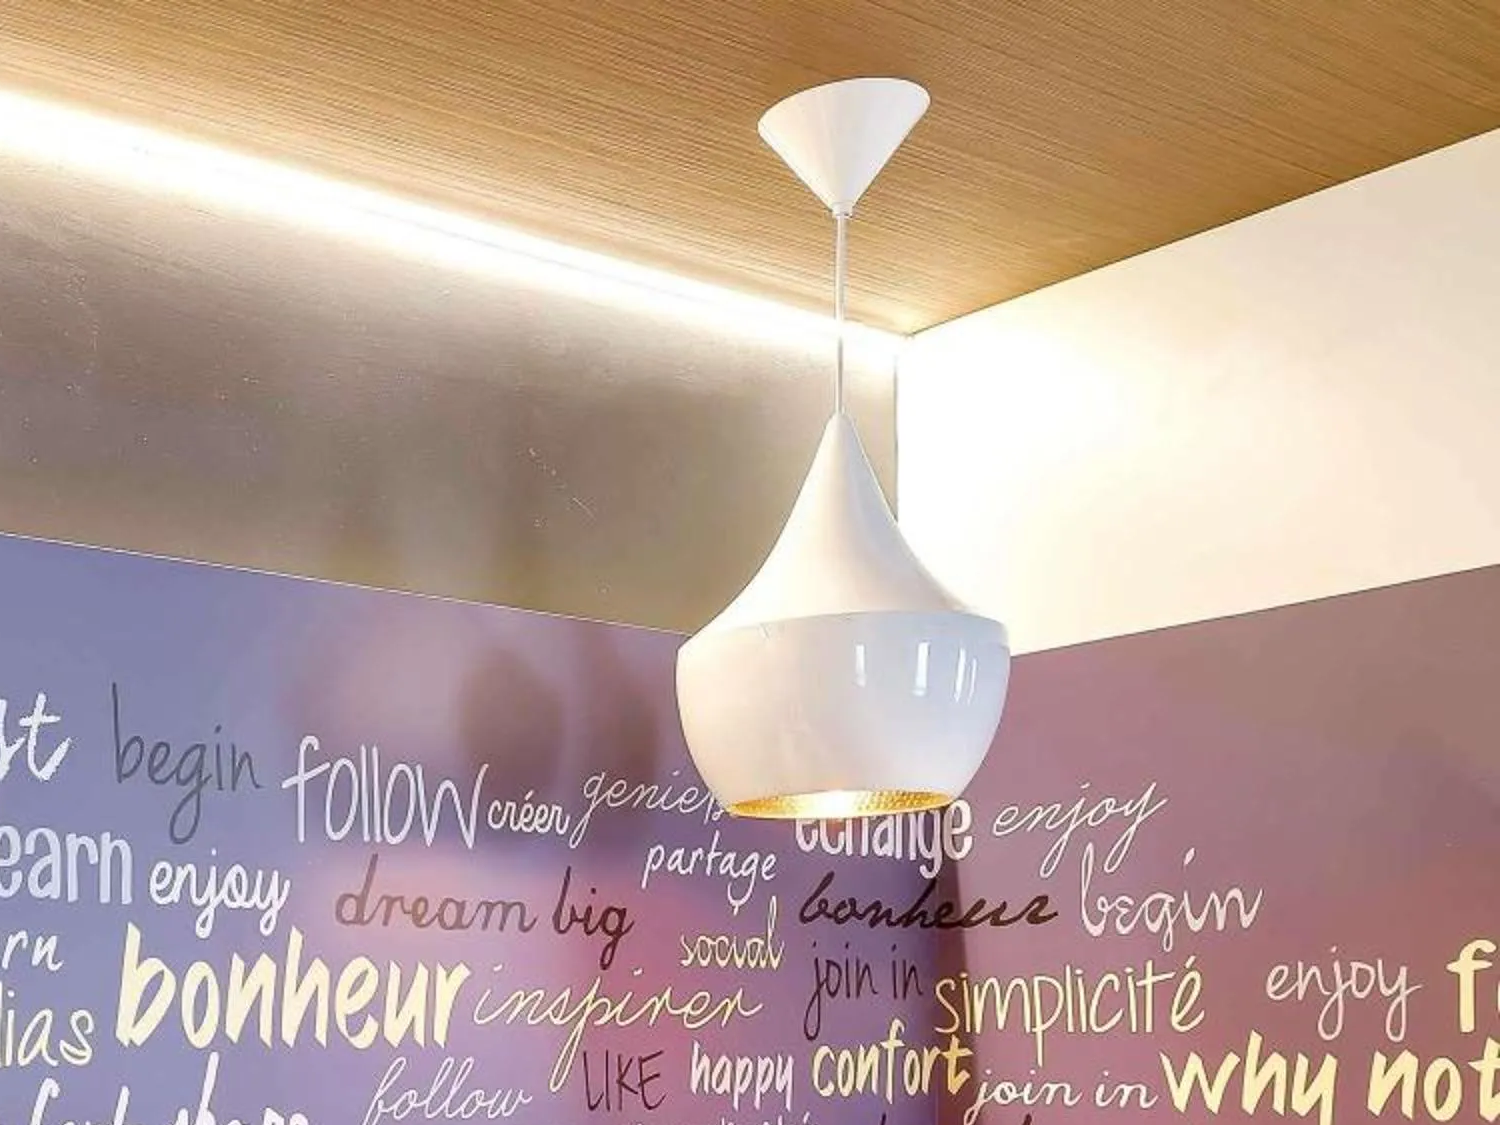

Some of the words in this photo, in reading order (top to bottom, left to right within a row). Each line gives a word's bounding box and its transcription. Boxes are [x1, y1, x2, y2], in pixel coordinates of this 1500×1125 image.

[111, 683, 263, 844] begin
[281, 735, 490, 848] follow
[486, 790, 571, 835] créer
[992, 782, 1168, 878] enjoy
[148, 850, 290, 938] enjoy
[334, 855, 538, 935] dream
[551, 867, 634, 969] big
[640, 829, 778, 904] partage
[799, 870, 1058, 930] bonheur
[1078, 843, 1264, 952] begin
[680, 896, 786, 970] social
[114, 922, 472, 1050] bonheur
[472, 963, 763, 1093] inspirer
[804, 942, 876, 1041] join
[892, 942, 926, 1000] in
[932, 955, 1205, 1067] simplicité
[1265, 945, 1422, 1043] enjoy
[581, 1049, 669, 1112] LIKE
[690, 1041, 793, 1112] happy
[812, 1018, 976, 1103] confort
[1093, 1070, 1160, 1110] in
[1367, 1036, 1500, 1123] not
